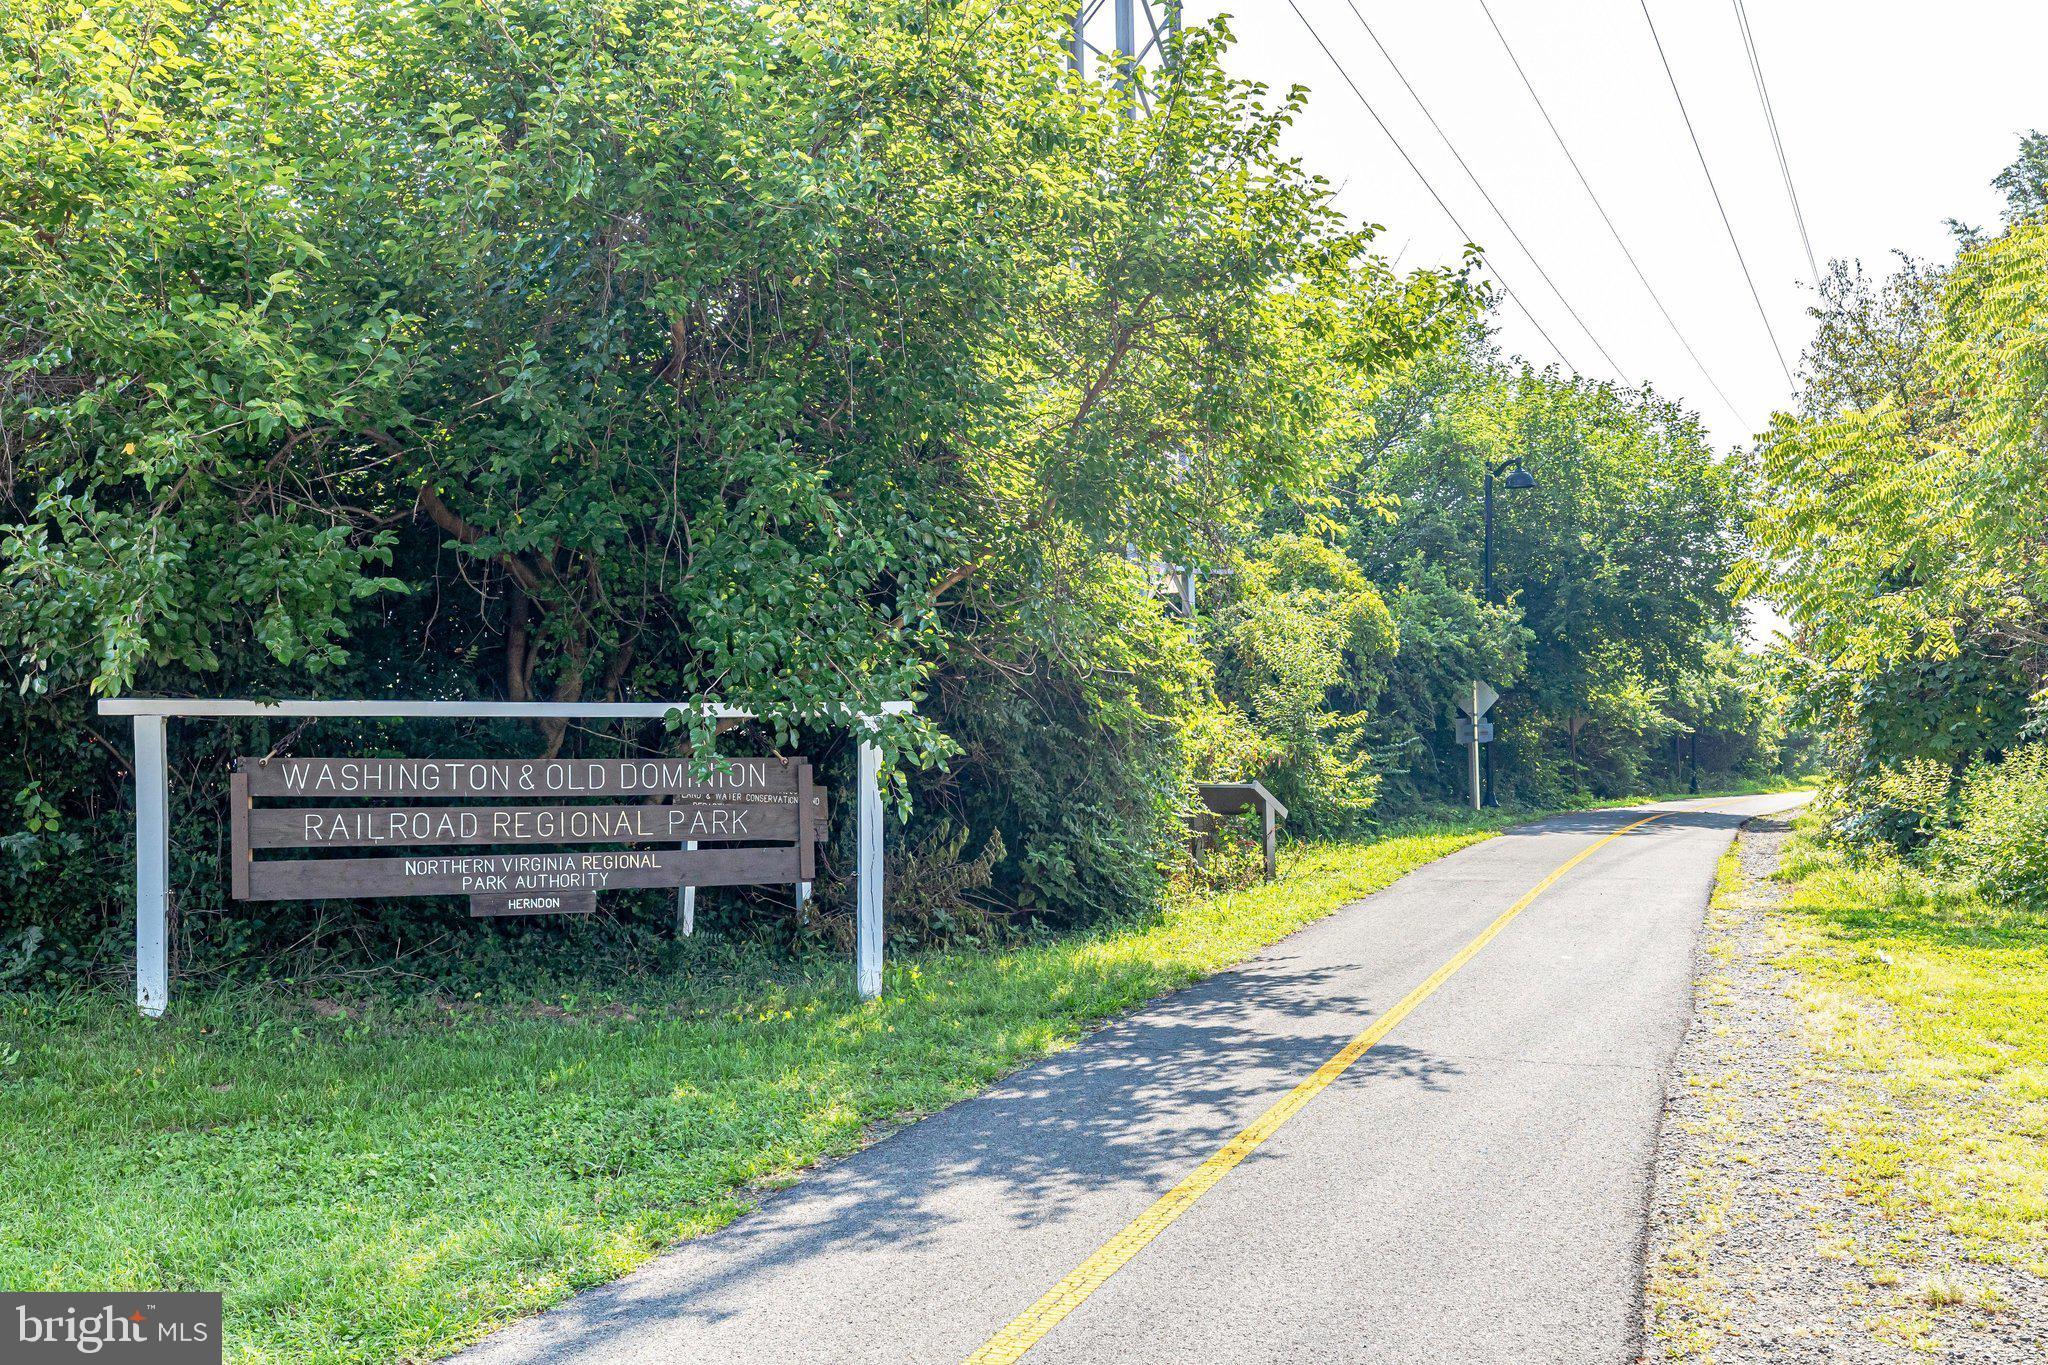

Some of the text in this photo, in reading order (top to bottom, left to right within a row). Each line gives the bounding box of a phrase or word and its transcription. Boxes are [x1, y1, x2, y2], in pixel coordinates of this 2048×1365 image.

[281, 763, 509, 791] WASHINGTON
[518, 763, 535, 791] &
[546, 763, 606, 791] OLD
[745, 793, 799, 804] CONSERVATION
[305, 809, 749, 841] RAILROAD REGIONAL PARK
[405, 853, 662, 876] NORTHERN VIRGINIA REGIONAL
[462, 872, 609, 891] PARK AUTHORITY
[508, 897, 560, 910] HERNDON
